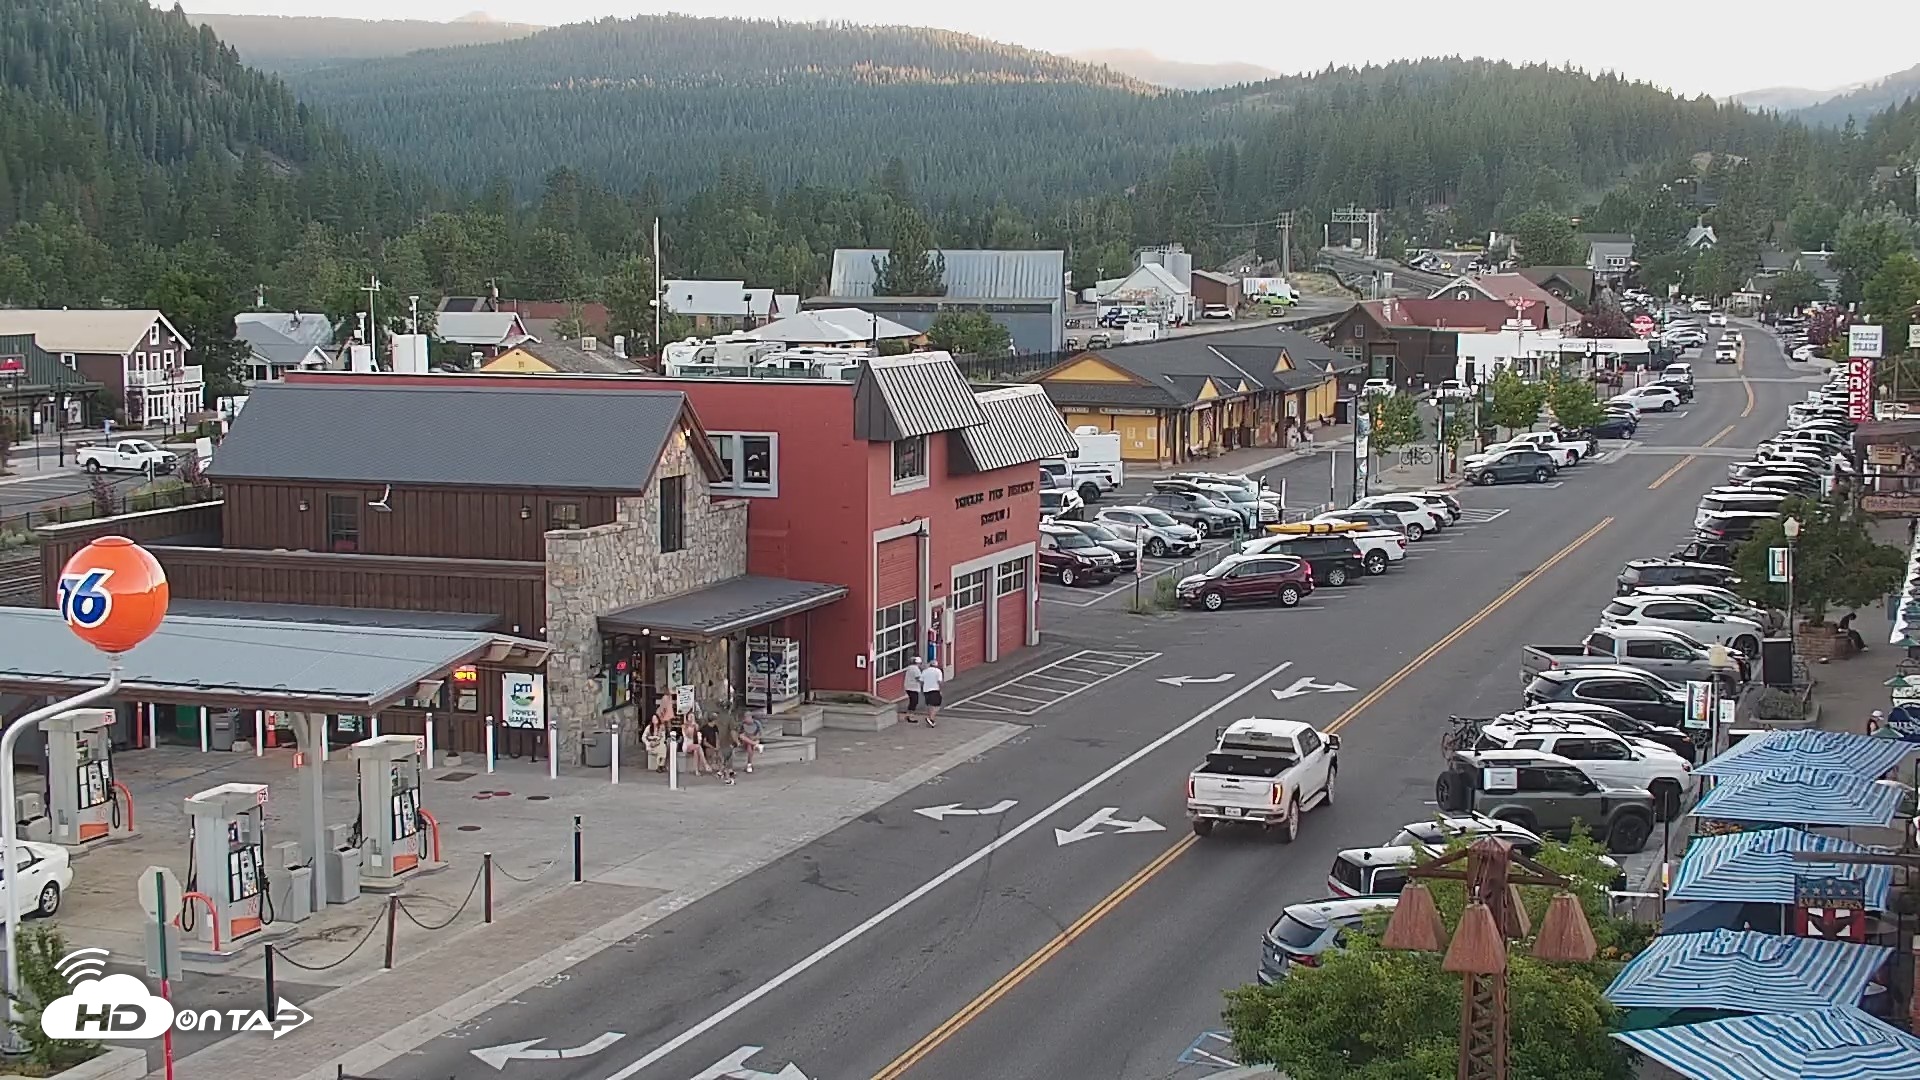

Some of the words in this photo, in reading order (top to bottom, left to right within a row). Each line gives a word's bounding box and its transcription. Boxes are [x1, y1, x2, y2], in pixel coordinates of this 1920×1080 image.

[1849, 361, 1862, 419] CAFE
[60, 569, 113, 628] 76
[513, 682, 532, 696] pm
